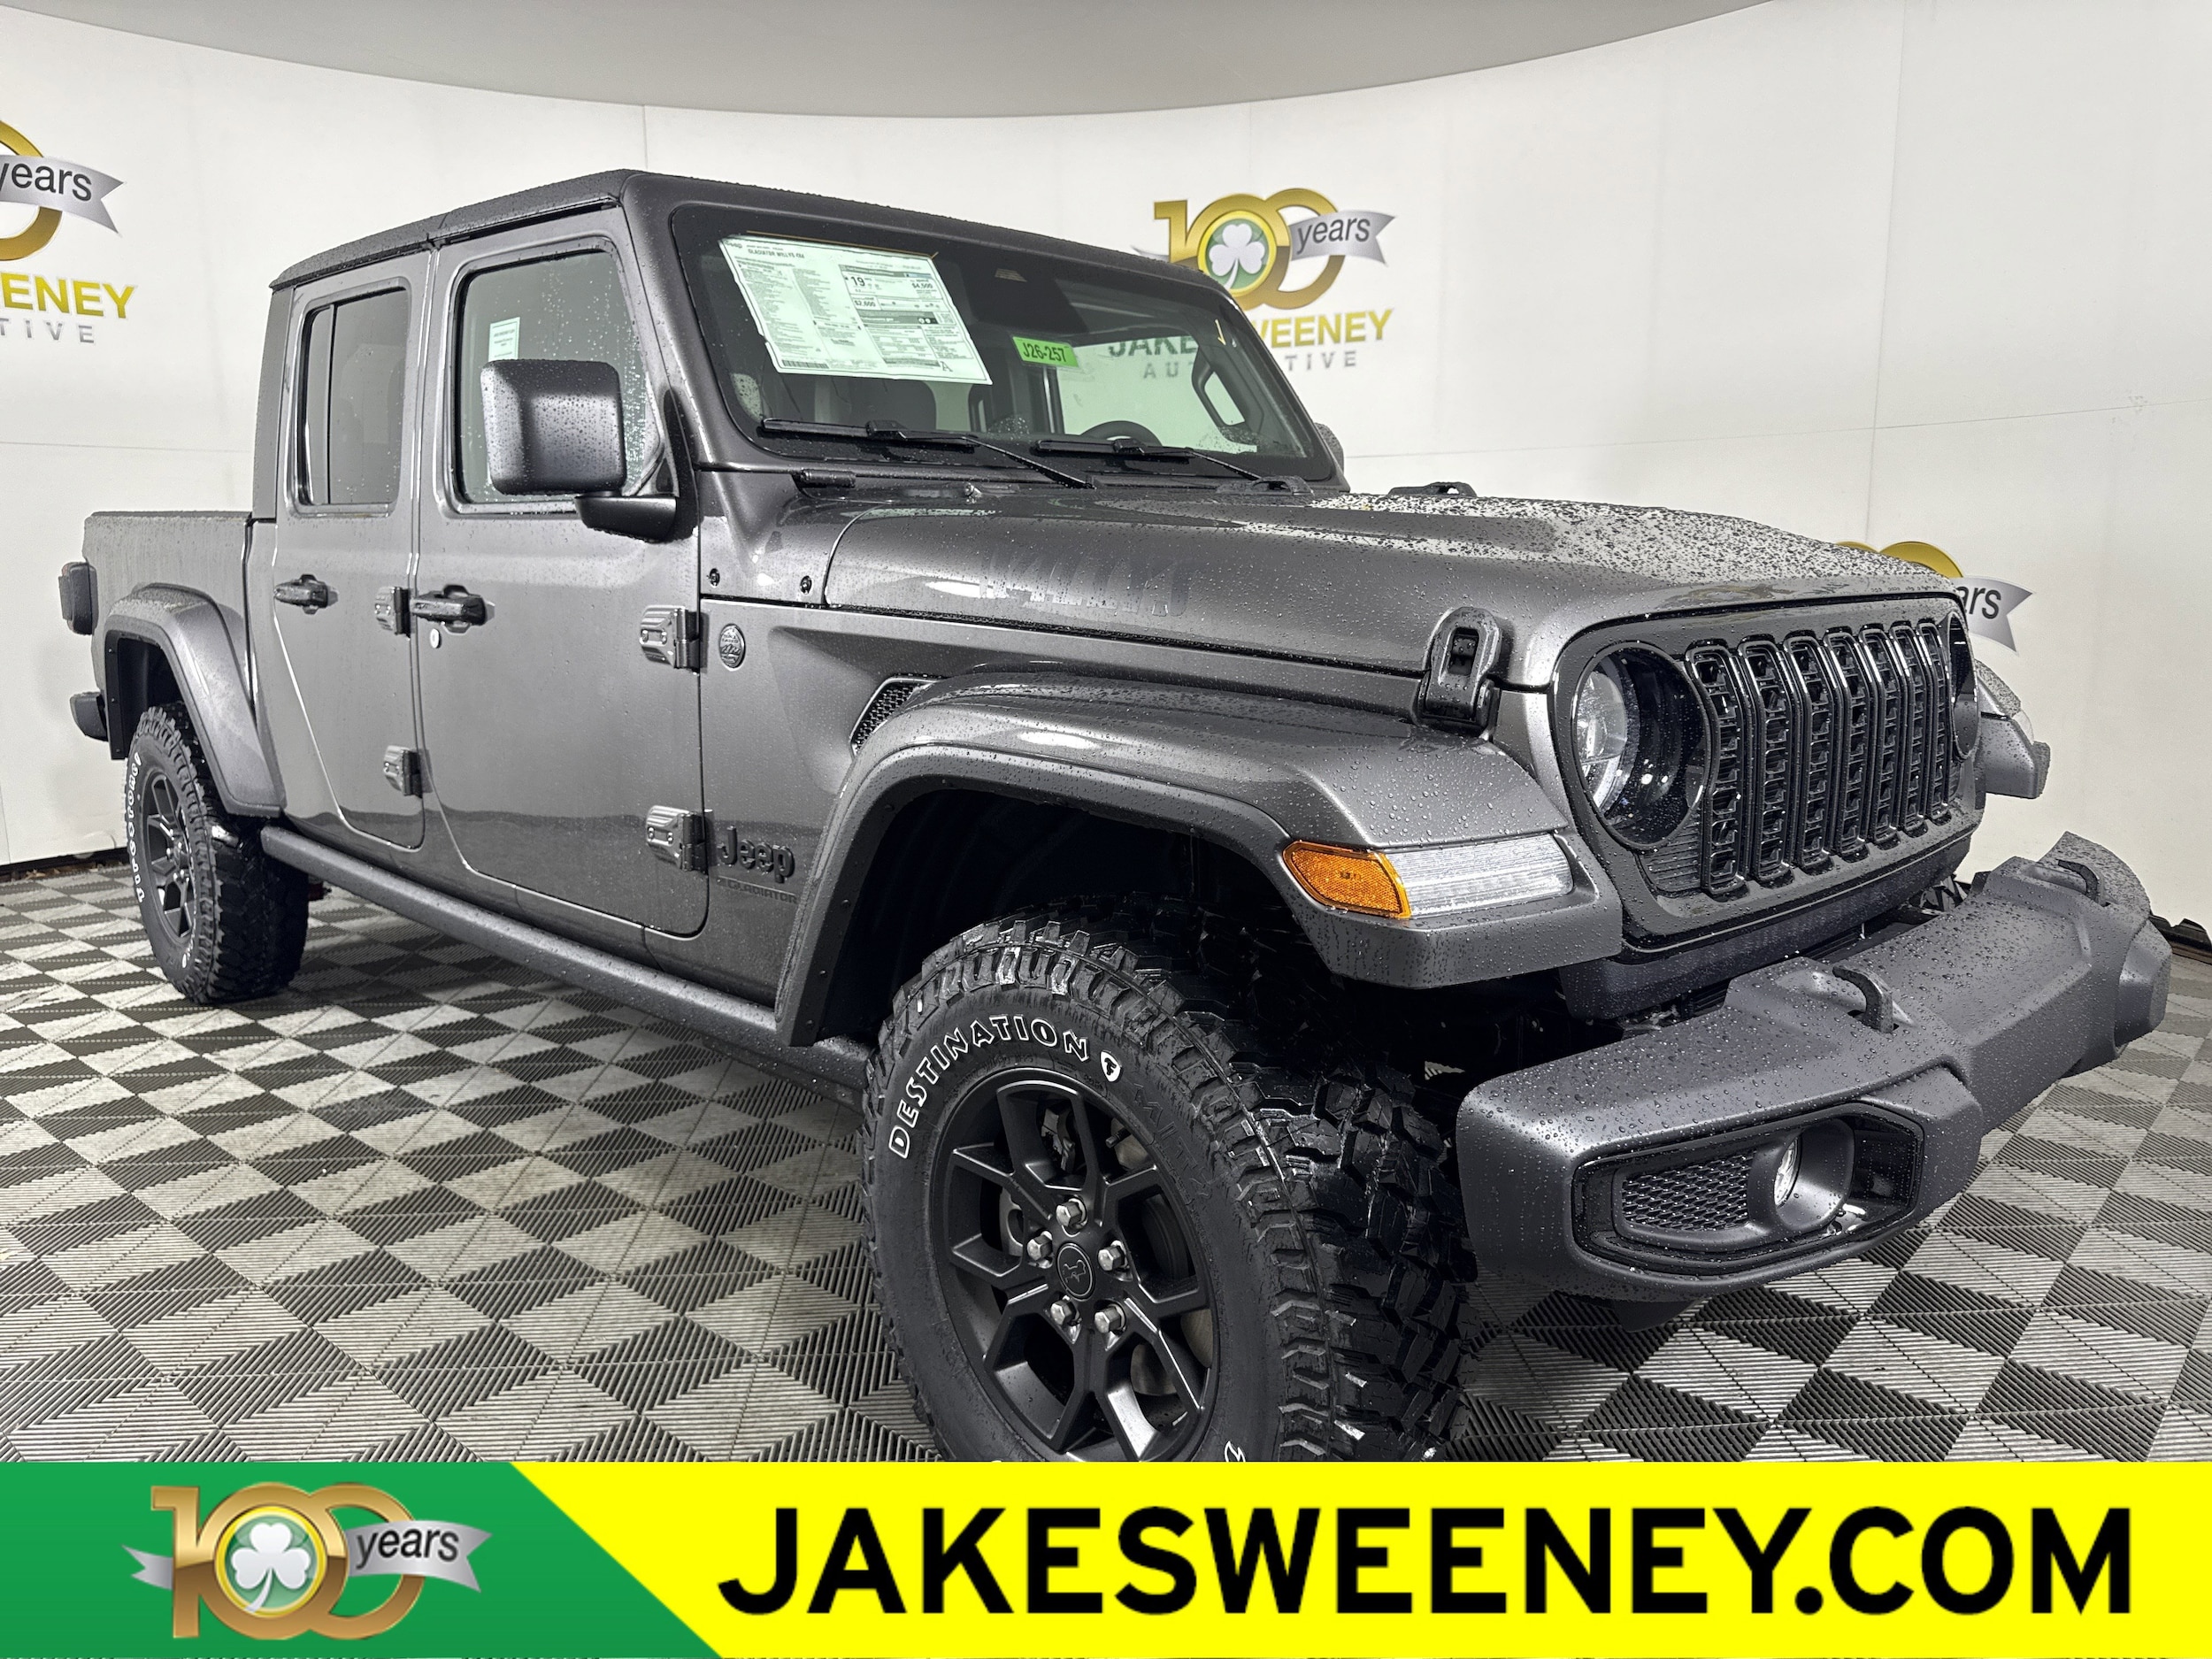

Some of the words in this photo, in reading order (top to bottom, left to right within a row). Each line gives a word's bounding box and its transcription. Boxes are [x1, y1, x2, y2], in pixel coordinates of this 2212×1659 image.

[1296, 217, 1371, 254] years
[851, 276, 865, 287] 19
[1252, 309, 1393, 349] EENEY
[1023, 342, 1066, 362] J26-257
[718, 825, 795, 884] Jeep
[888, 1014, 1089, 1159] DESTINATION
